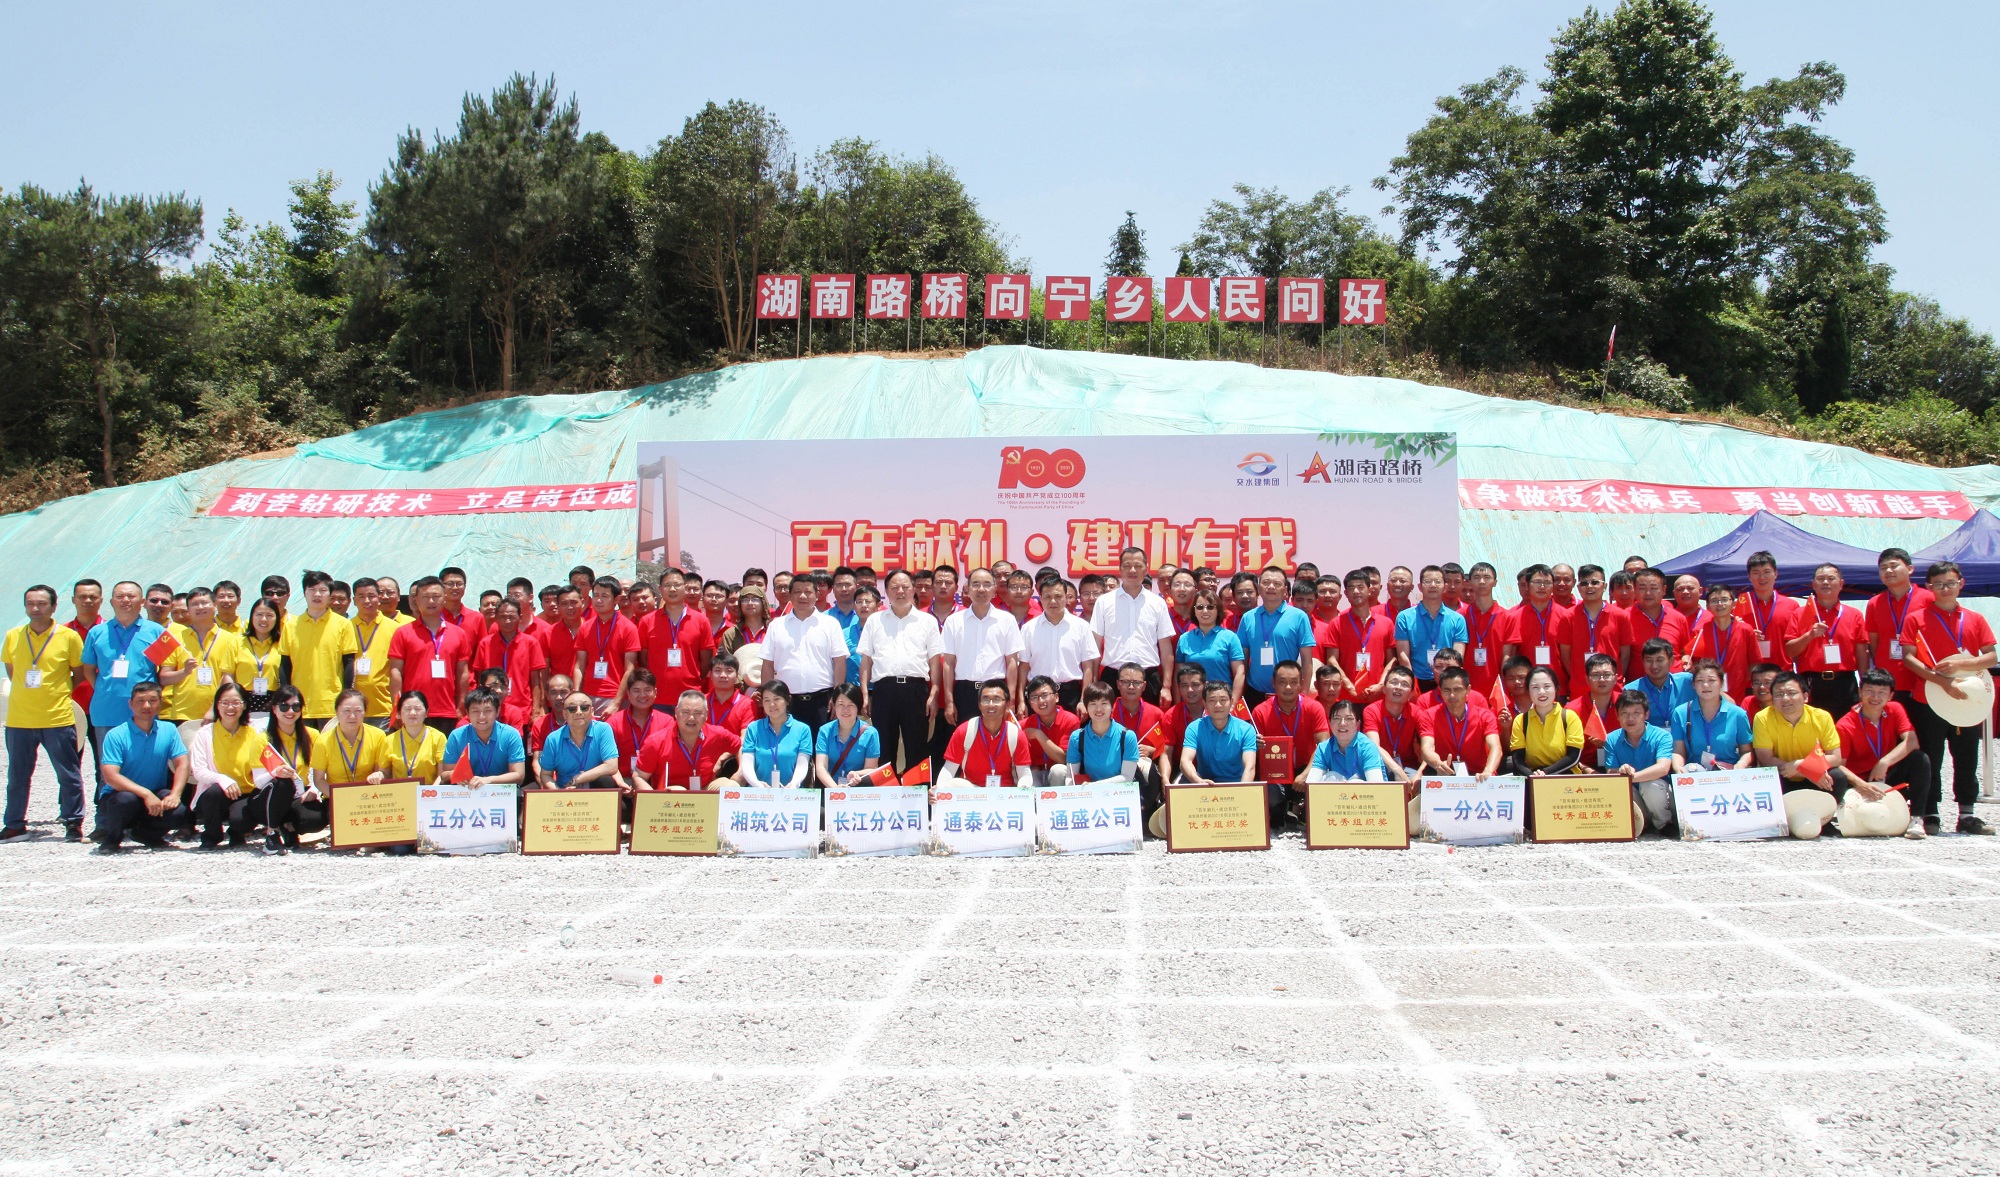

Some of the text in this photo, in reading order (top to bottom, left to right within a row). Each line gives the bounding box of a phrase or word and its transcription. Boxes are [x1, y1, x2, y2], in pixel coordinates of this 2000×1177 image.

[760, 275, 1382, 323] 湖南路桥向宁乡人民问好
[1334, 459, 1422, 475] 湖南路桥
[1236, 478, 1280, 486] 交水建集团
[228, 484, 637, 513] 刻苦钻研技术 立足岗位成
[1476, 483, 1956, 516] 争做技术标兵 勇当创新能手
[1433, 799, 1513, 821] 一分公司
[1690, 791, 1773, 815] 二分公司
[350, 815, 406, 826] 优秀组织奖
[429, 808, 506, 828] 五分公司
[730, 810, 809, 833] 湘筑公司
[833, 810, 922, 832] 长江分公司
[943, 810, 1024, 832] 通泰公司
[1049, 807, 1131, 830] 通盛公司
[1188, 819, 1248, 830] 优秀组织奖
[1327, 818, 1388, 826] 优秀组织奖
[1552, 811, 1614, 820] 优秀组织奖
[542, 824, 600, 833] 优秀组织奖
[649, 825, 704, 834] 优秀组织奖
